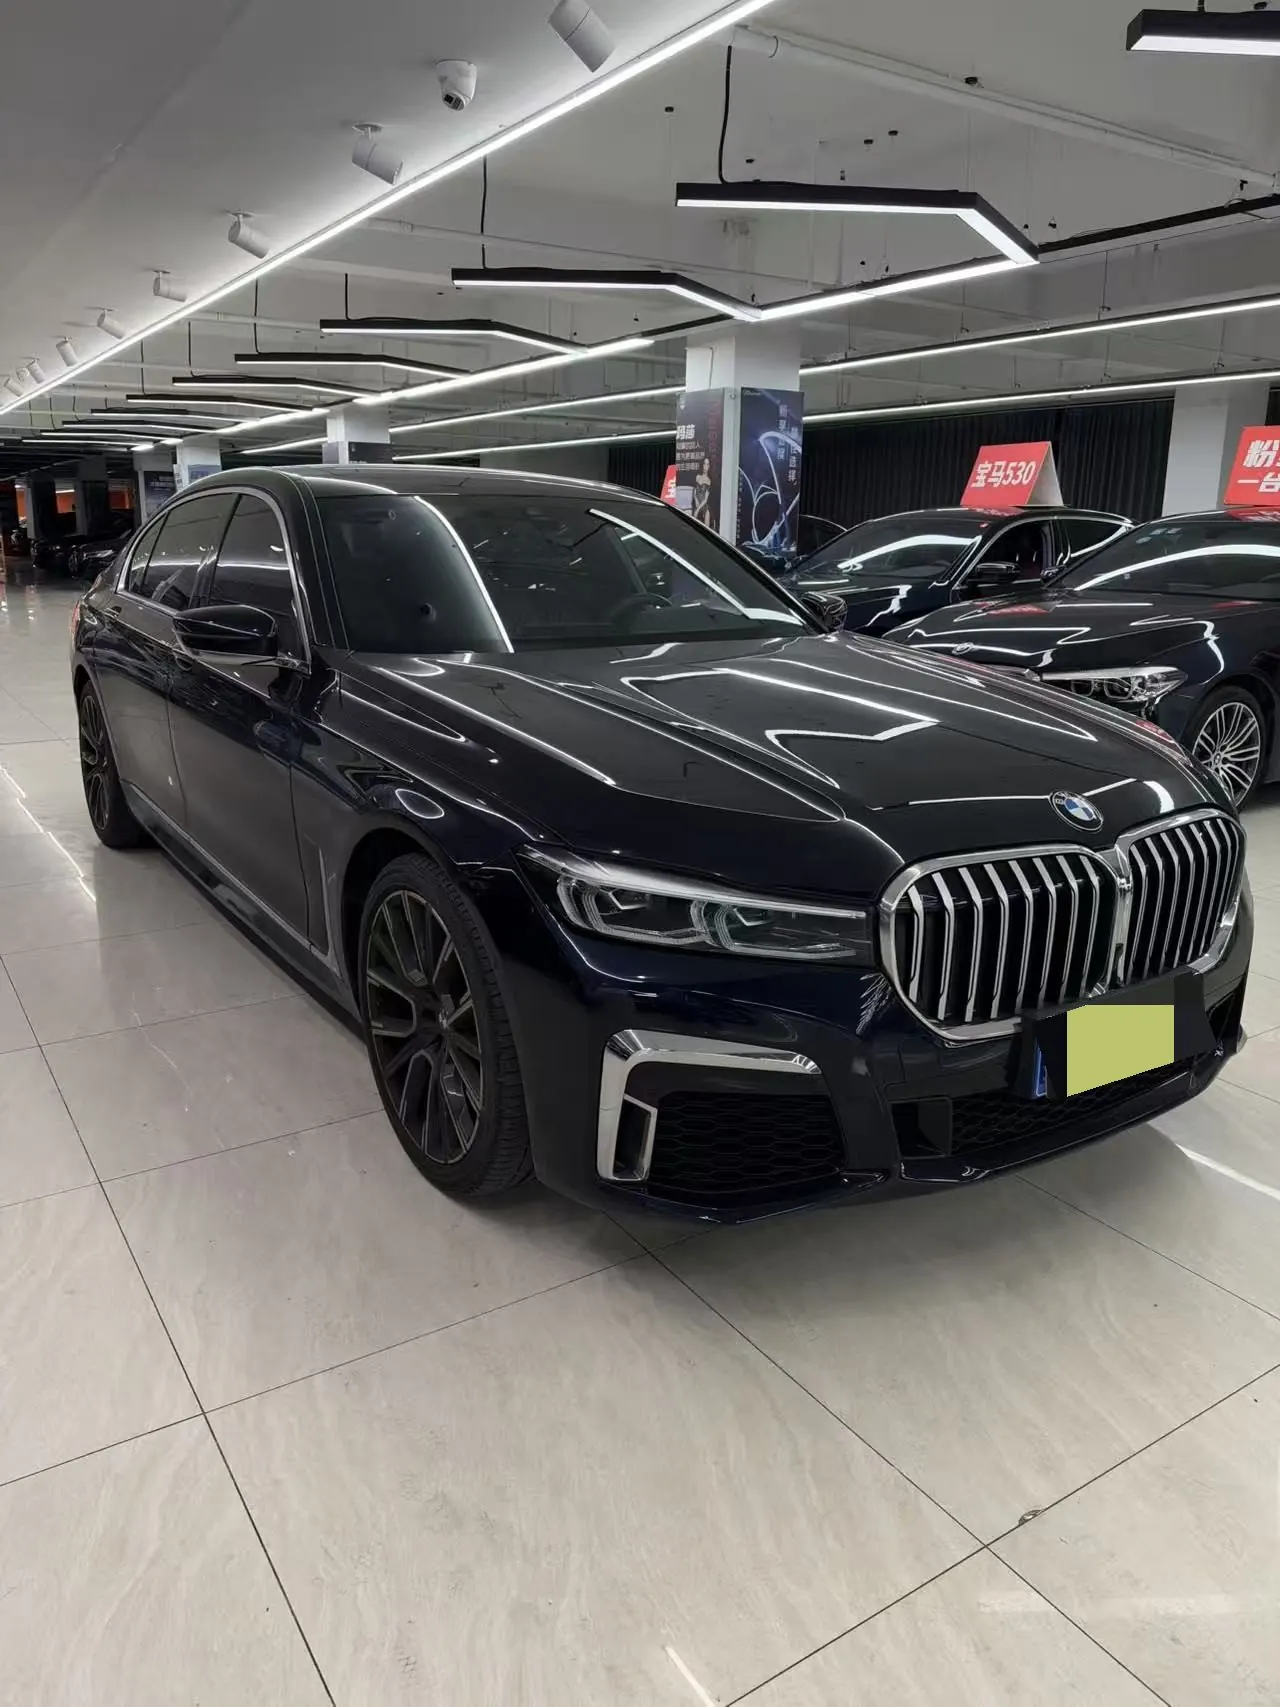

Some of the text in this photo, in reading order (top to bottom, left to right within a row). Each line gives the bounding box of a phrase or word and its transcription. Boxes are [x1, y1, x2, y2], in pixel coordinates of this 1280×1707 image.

[1243, 440, 1280, 468] 粉
[971, 460, 1036, 488] 宝马530
[1237, 472, 1280, 493] 一台
